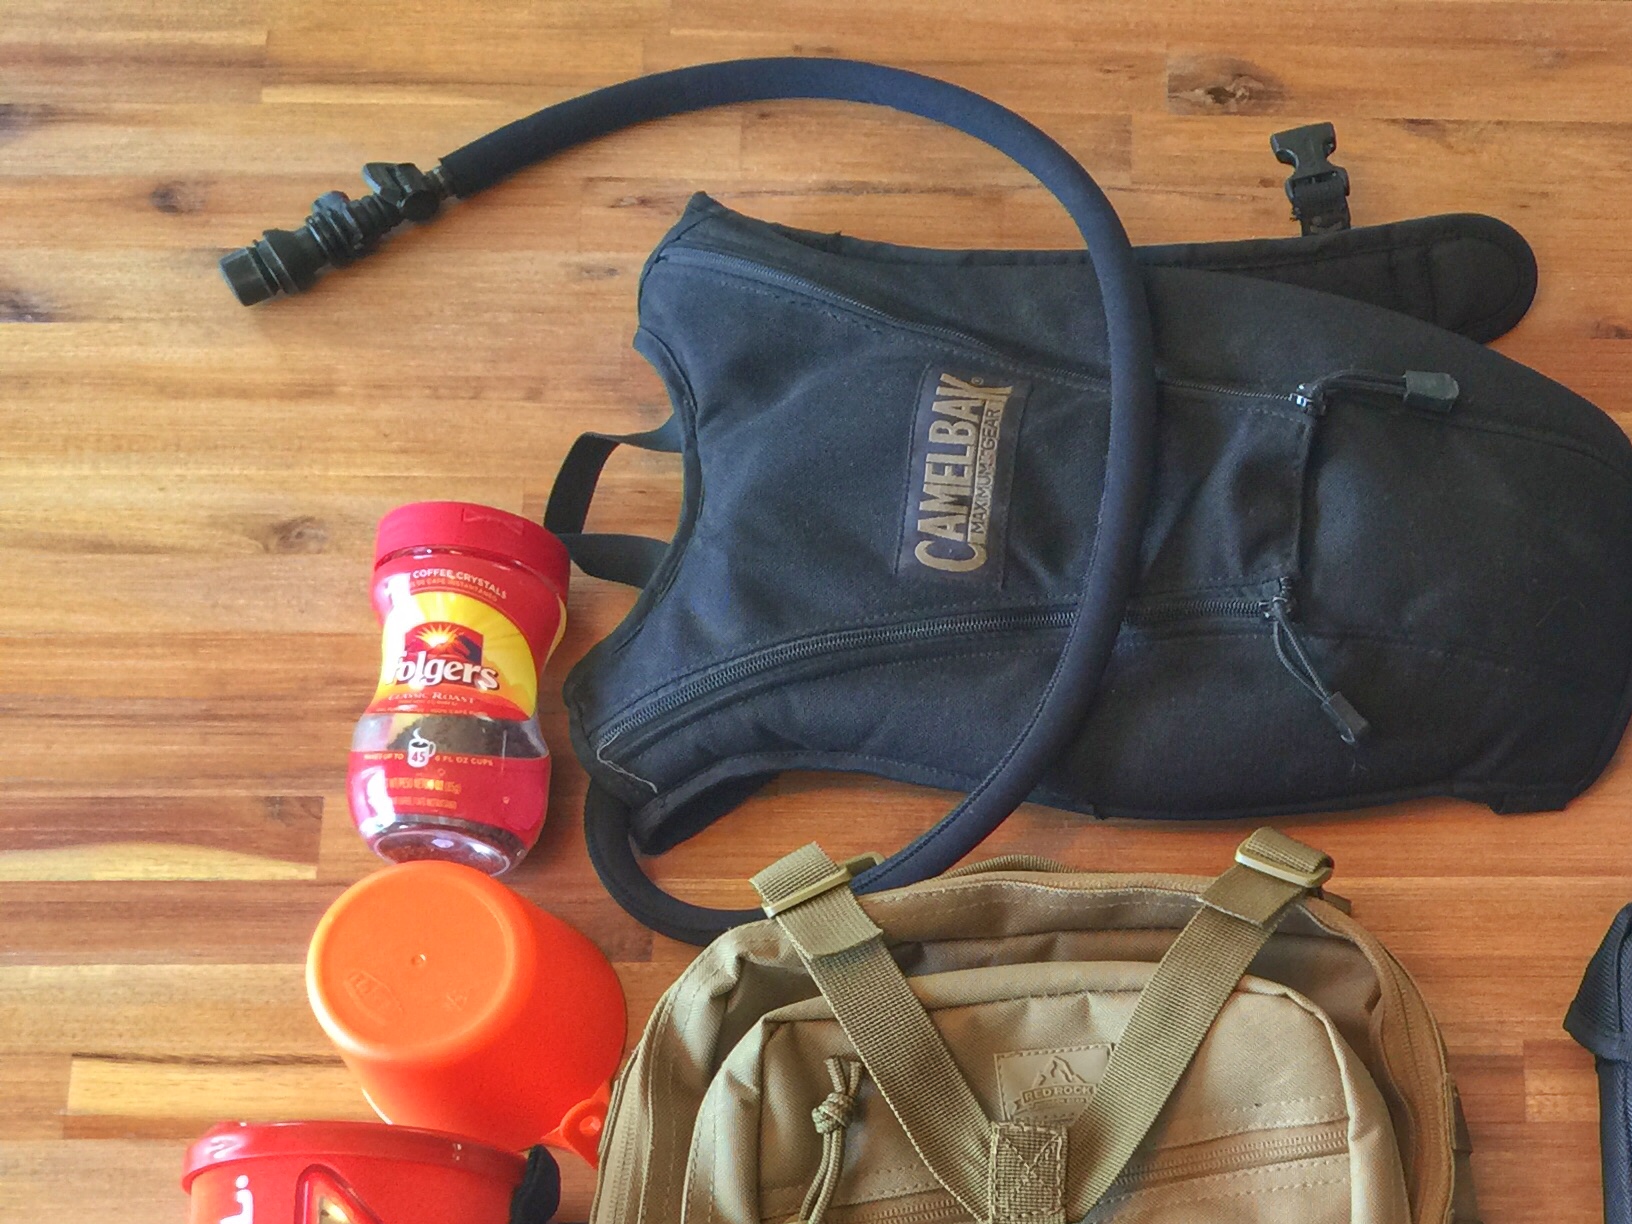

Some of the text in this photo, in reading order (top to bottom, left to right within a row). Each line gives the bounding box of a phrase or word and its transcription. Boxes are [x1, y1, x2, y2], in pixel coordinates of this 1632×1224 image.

[915, 373, 1012, 572] CAMELBAK
[971, 408, 1001, 534] MAXIMUM GEAR
[412, 568, 507, 600] COFFEE CRYSTALS
[411, 751, 426, 763] 45
[470, 758, 494, 767] CUPS
